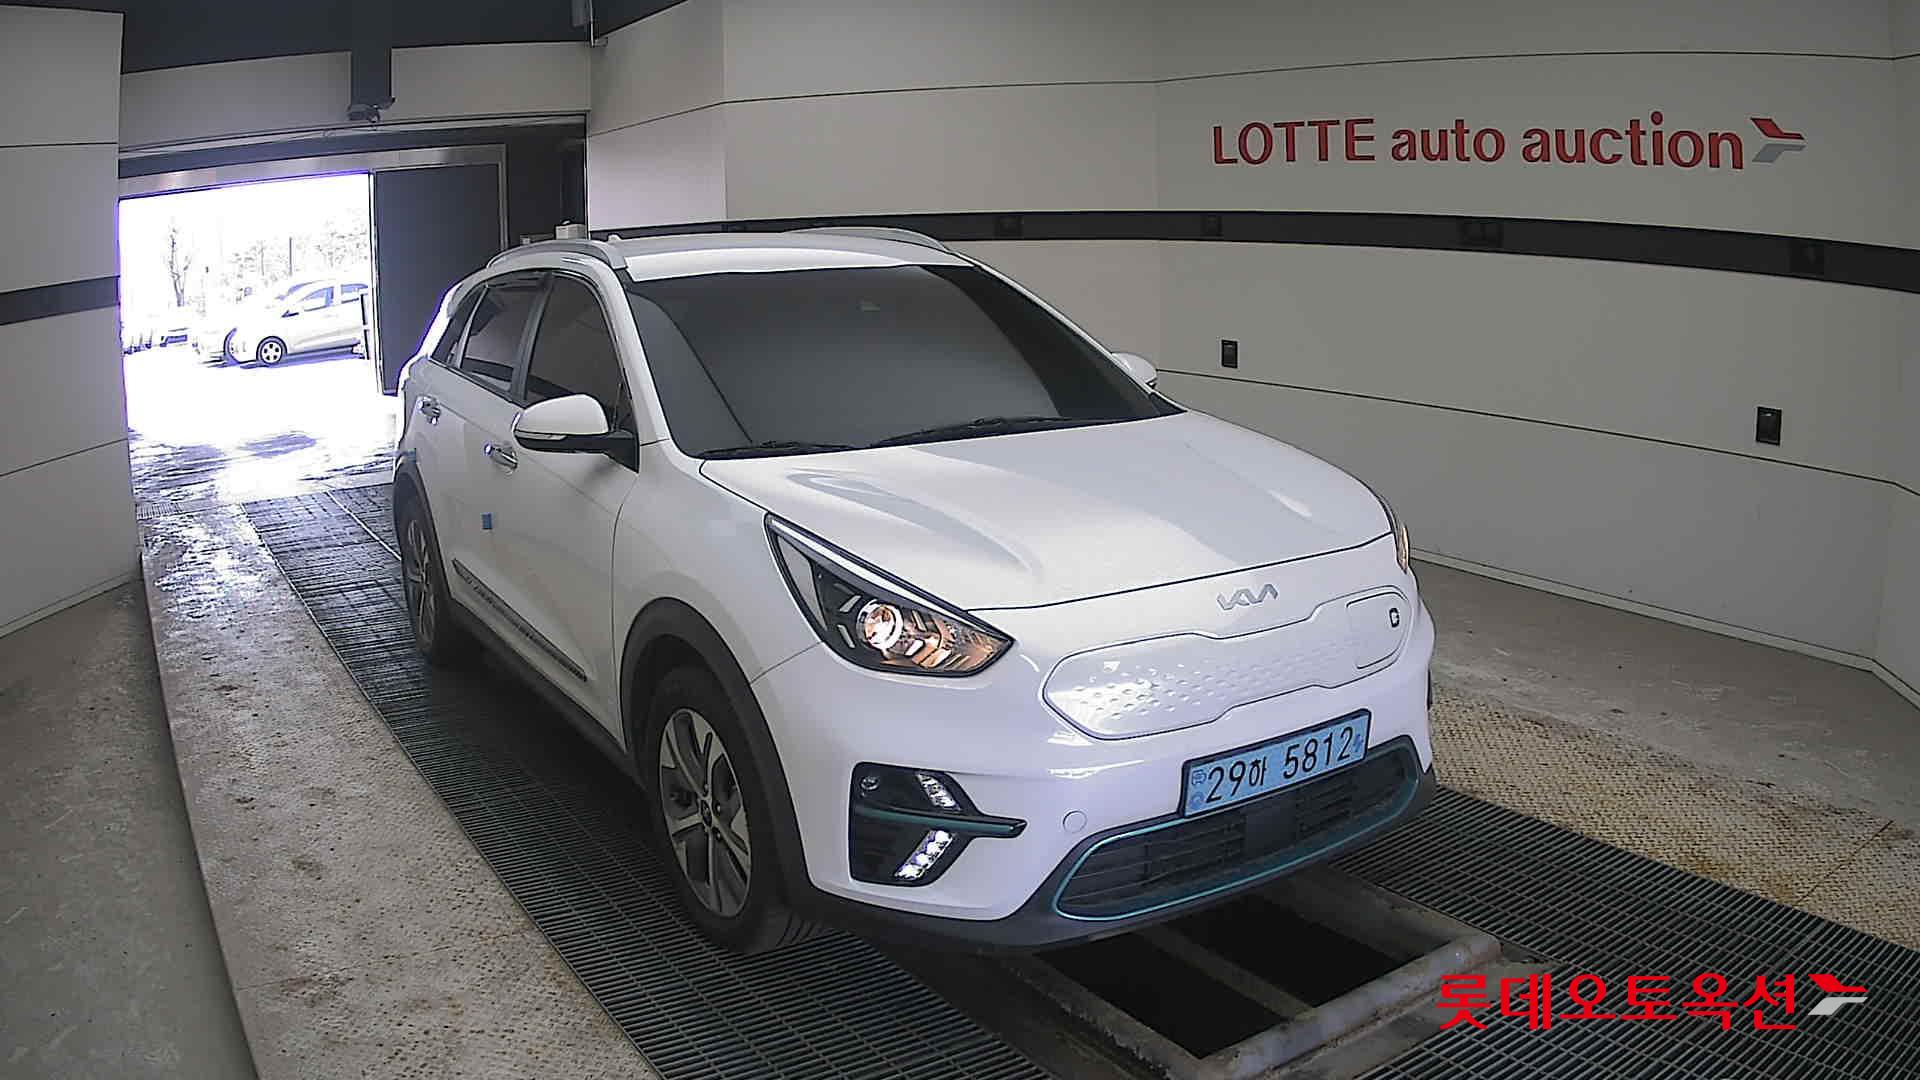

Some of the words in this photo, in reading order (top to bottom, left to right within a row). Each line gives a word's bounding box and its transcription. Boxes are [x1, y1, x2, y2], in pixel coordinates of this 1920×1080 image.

[1213, 117, 1376, 165] LOTTE
[1391, 119, 1506, 163] auto
[1522, 111, 1744, 170] auction
[1205, 756, 1267, 804] 29하
[1282, 726, 1354, 780] 5812
